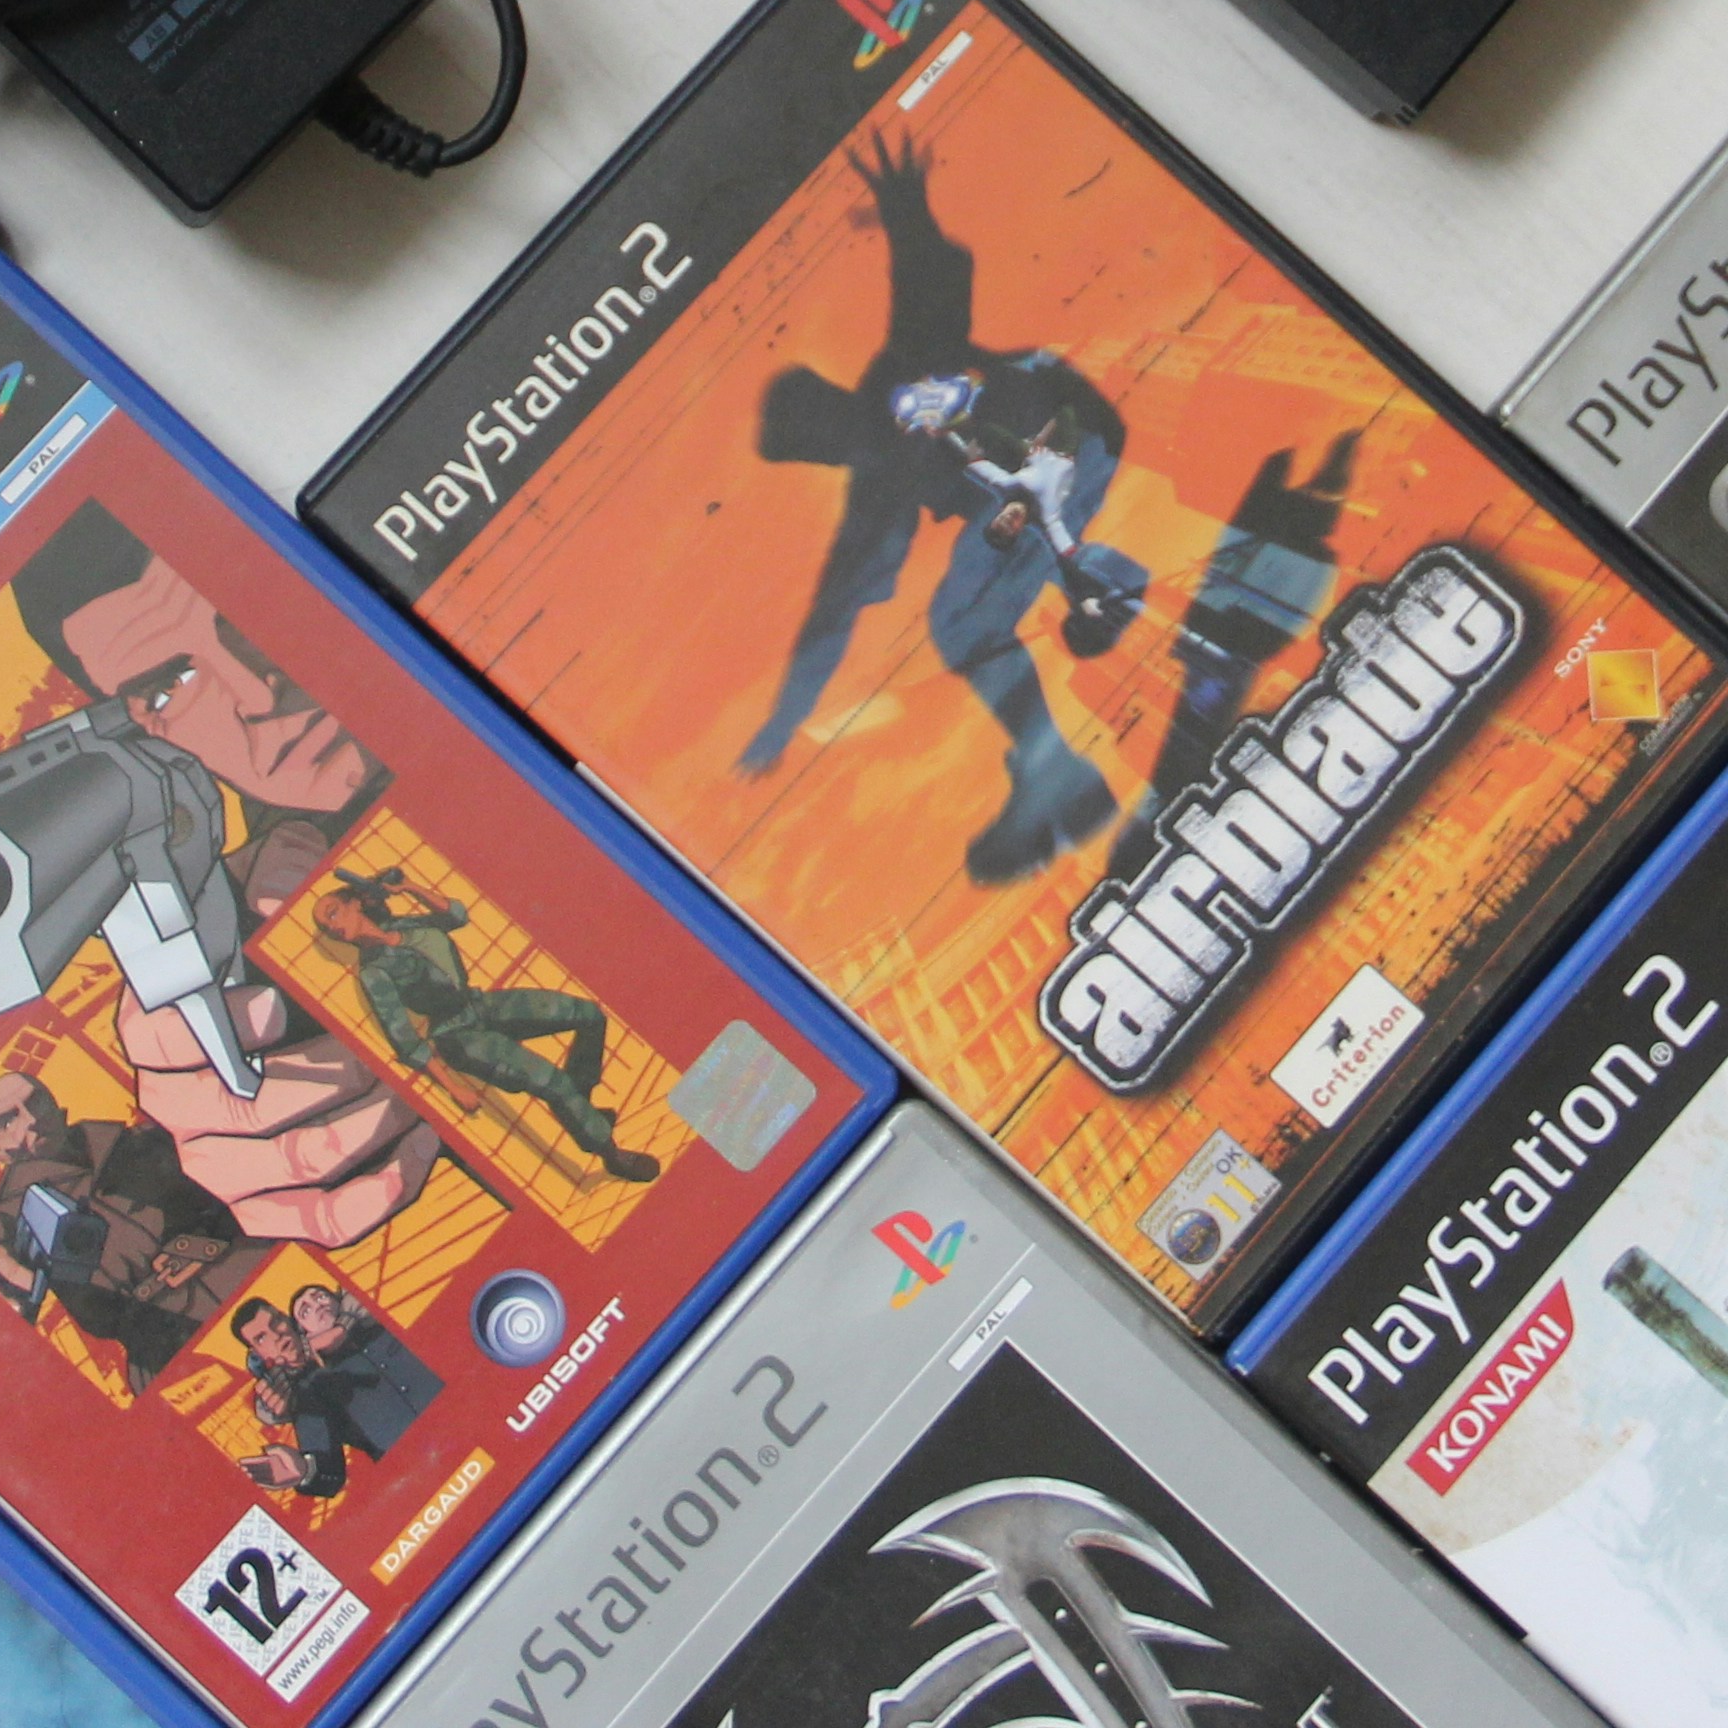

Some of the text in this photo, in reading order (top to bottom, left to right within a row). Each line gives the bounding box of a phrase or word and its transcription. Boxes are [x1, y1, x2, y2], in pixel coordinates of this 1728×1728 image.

[27, 441, 61, 477] PAL
[1554, 615, 1607, 679] SONY
[1059, 562, 1506, 1071] airblade
[1310, 1000, 1406, 1110] Criterion
[1216, 1144, 1242, 1175] OK
[506, 1296, 628, 1436] UBISOFT
[1426, 1314, 1568, 1474] KONAMI
[380, 1460, 484, 1579] DARGAUD
[203, 1544, 308, 1645] 12+
[275, 1598, 359, 1691] www.pegi.info
